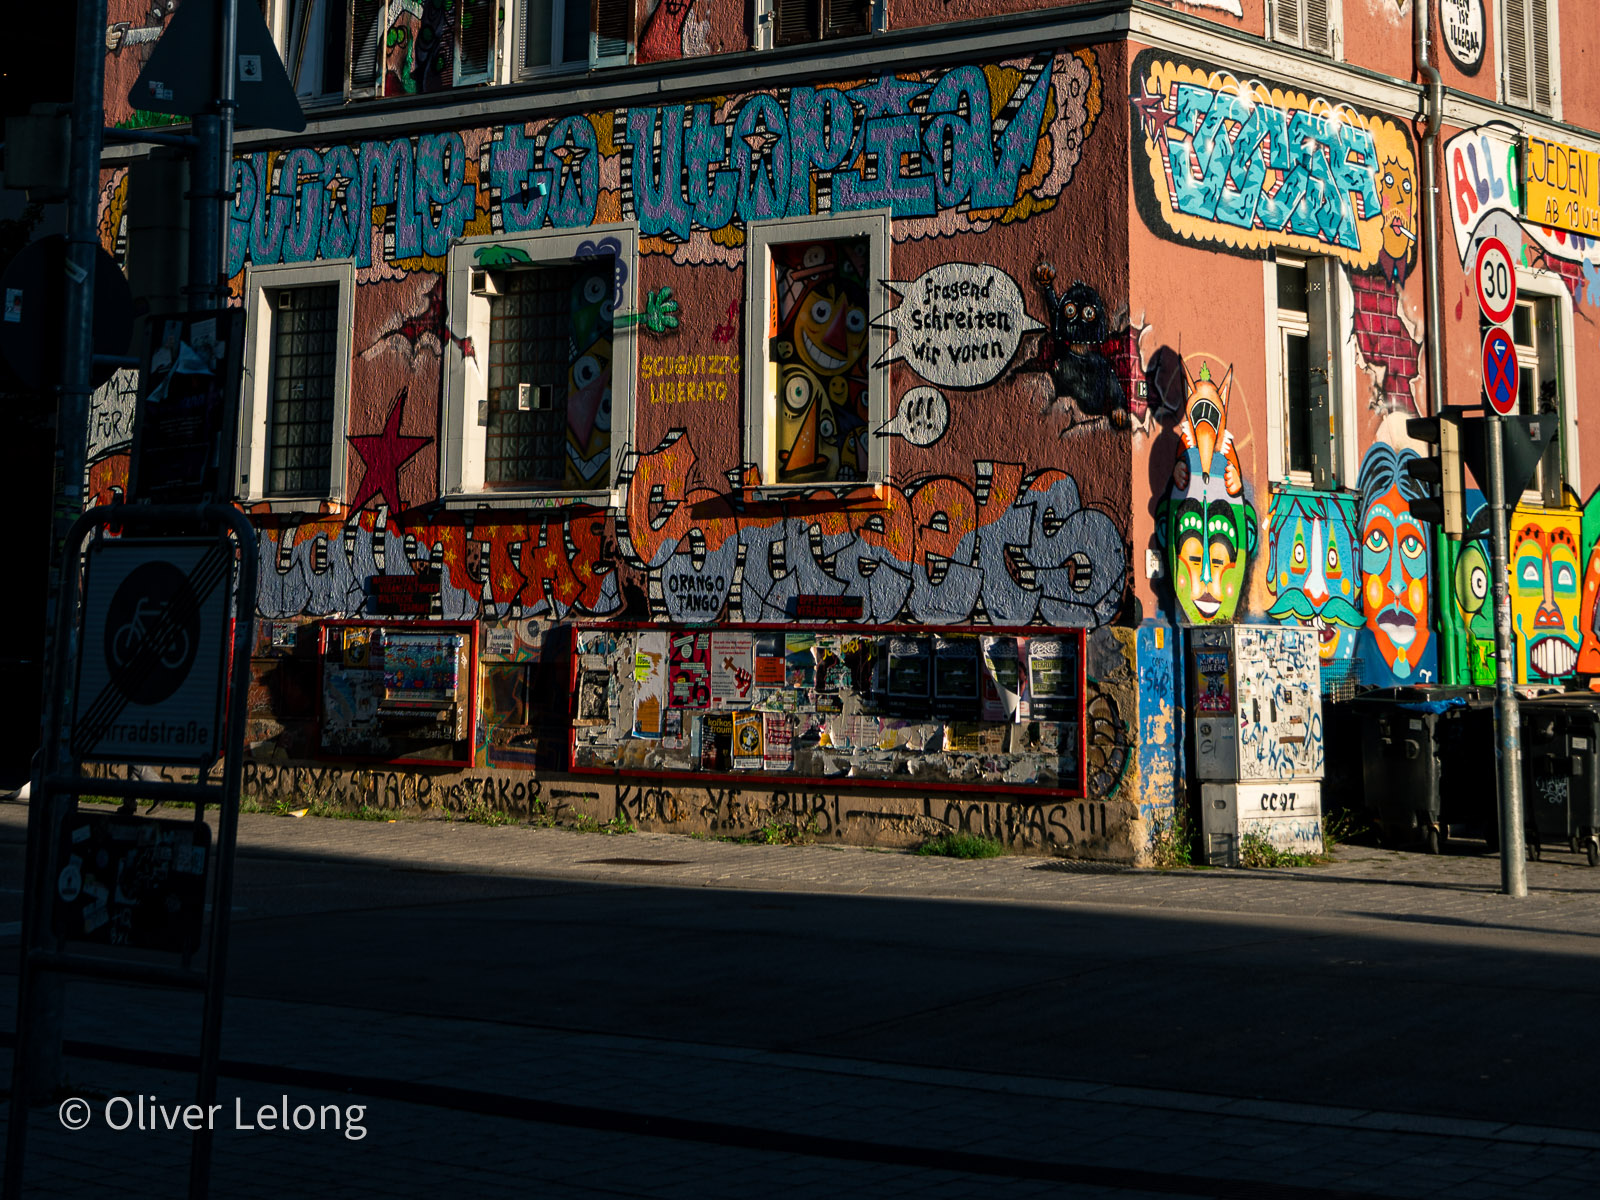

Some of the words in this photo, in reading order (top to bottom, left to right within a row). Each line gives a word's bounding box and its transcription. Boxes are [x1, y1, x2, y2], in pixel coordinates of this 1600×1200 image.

[1453, 135, 1504, 225] ALL
[1532, 137, 1588, 199] JEDEN
[1545, 197, 1560, 224] AB
[1565, 200, 1580, 228] 19
[923, 275, 995, 305] fragend
[1483, 259, 1509, 301] 30
[912, 337, 941, 365] wir
[948, 339, 1004, 367] voran
[650, 381, 728, 405] LIBERATO
[668, 574, 725, 592] ORANGO
[676, 593, 720, 612] TANGO
